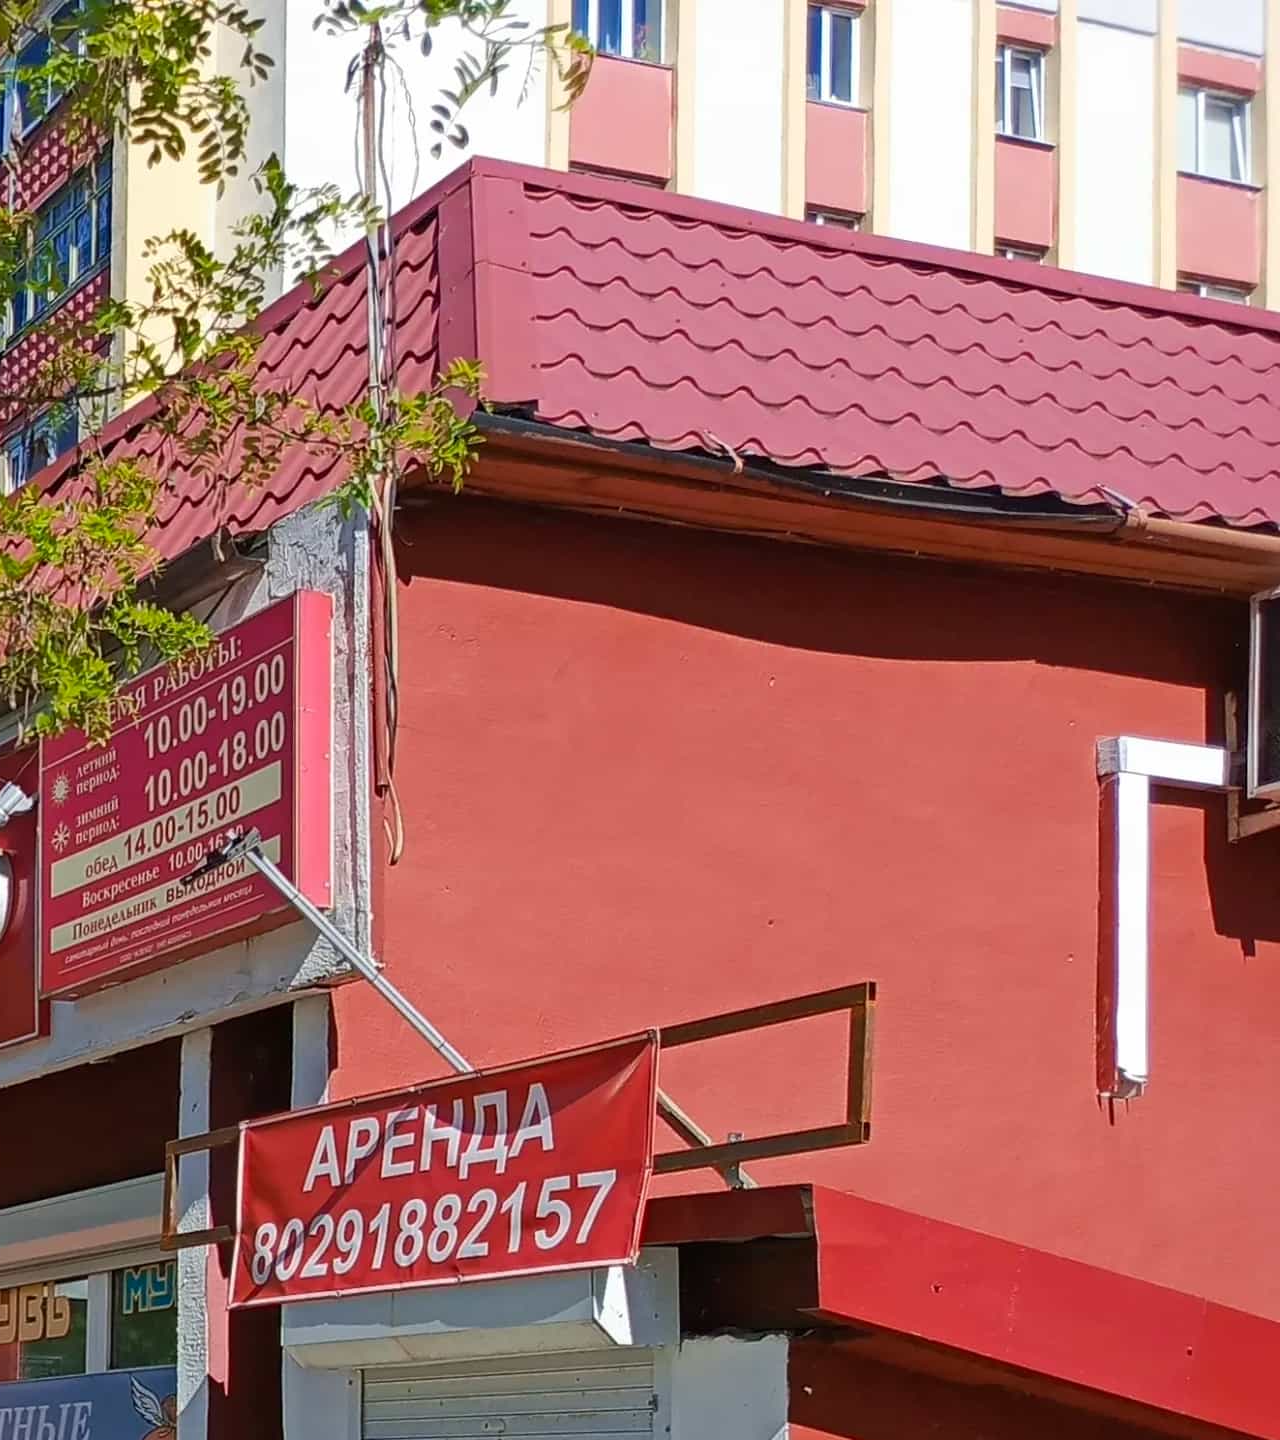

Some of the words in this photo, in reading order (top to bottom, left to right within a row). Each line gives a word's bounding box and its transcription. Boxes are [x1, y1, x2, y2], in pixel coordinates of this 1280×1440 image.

[86, 685, 148, 735] ЕМЯ
[143, 654, 285, 759] 10.00-19.00
[75, 747, 117, 779] летний
[76, 764, 120, 795] период:
[143, 711, 285, 812] 10.00-18.00
[75, 797, 119, 827] зимний
[75, 815, 120, 846] период:
[85, 857, 119, 879] обед
[123, 785, 241, 861] 14.00-15.00
[82, 865, 160, 908] Воскресенье
[71, 897, 158, 941] Понедельник
[302, 1082, 554, 1193] АРЕНДА
[250, 1169, 618, 1287] 80291882157
